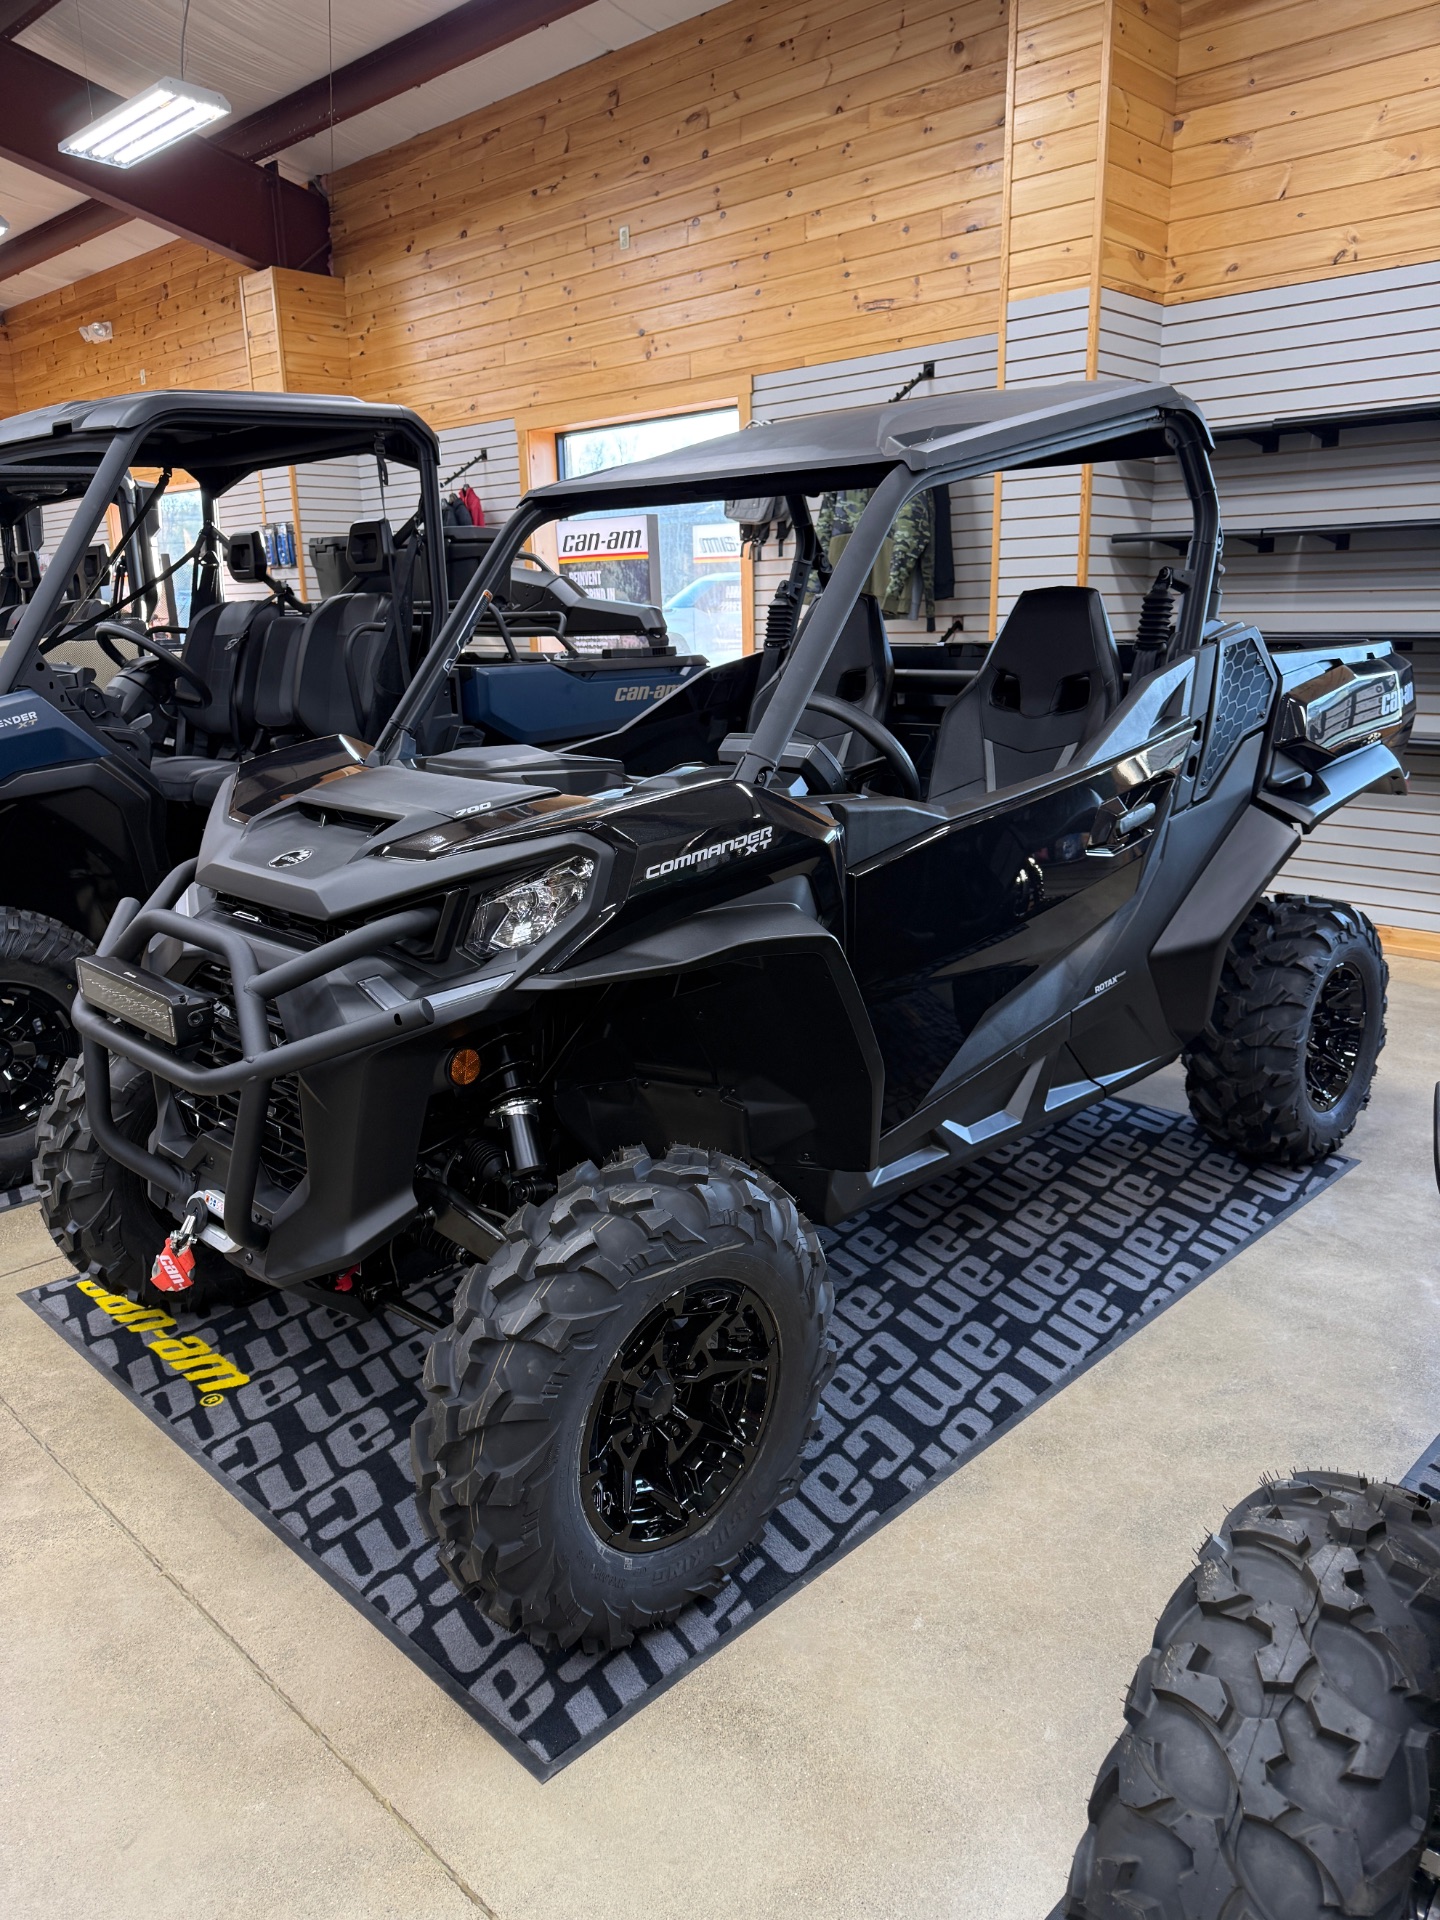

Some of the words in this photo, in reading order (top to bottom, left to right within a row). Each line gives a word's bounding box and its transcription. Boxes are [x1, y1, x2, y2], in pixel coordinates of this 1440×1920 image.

[562, 529, 642, 553] can-am
[0, 711, 38, 728] ENDER
[645, 826, 773, 880] COMMANDER
[744, 838, 772, 857] XT
[1094, 975, 1118, 994] ROTAX
[160, 1254, 185, 1289] can-
